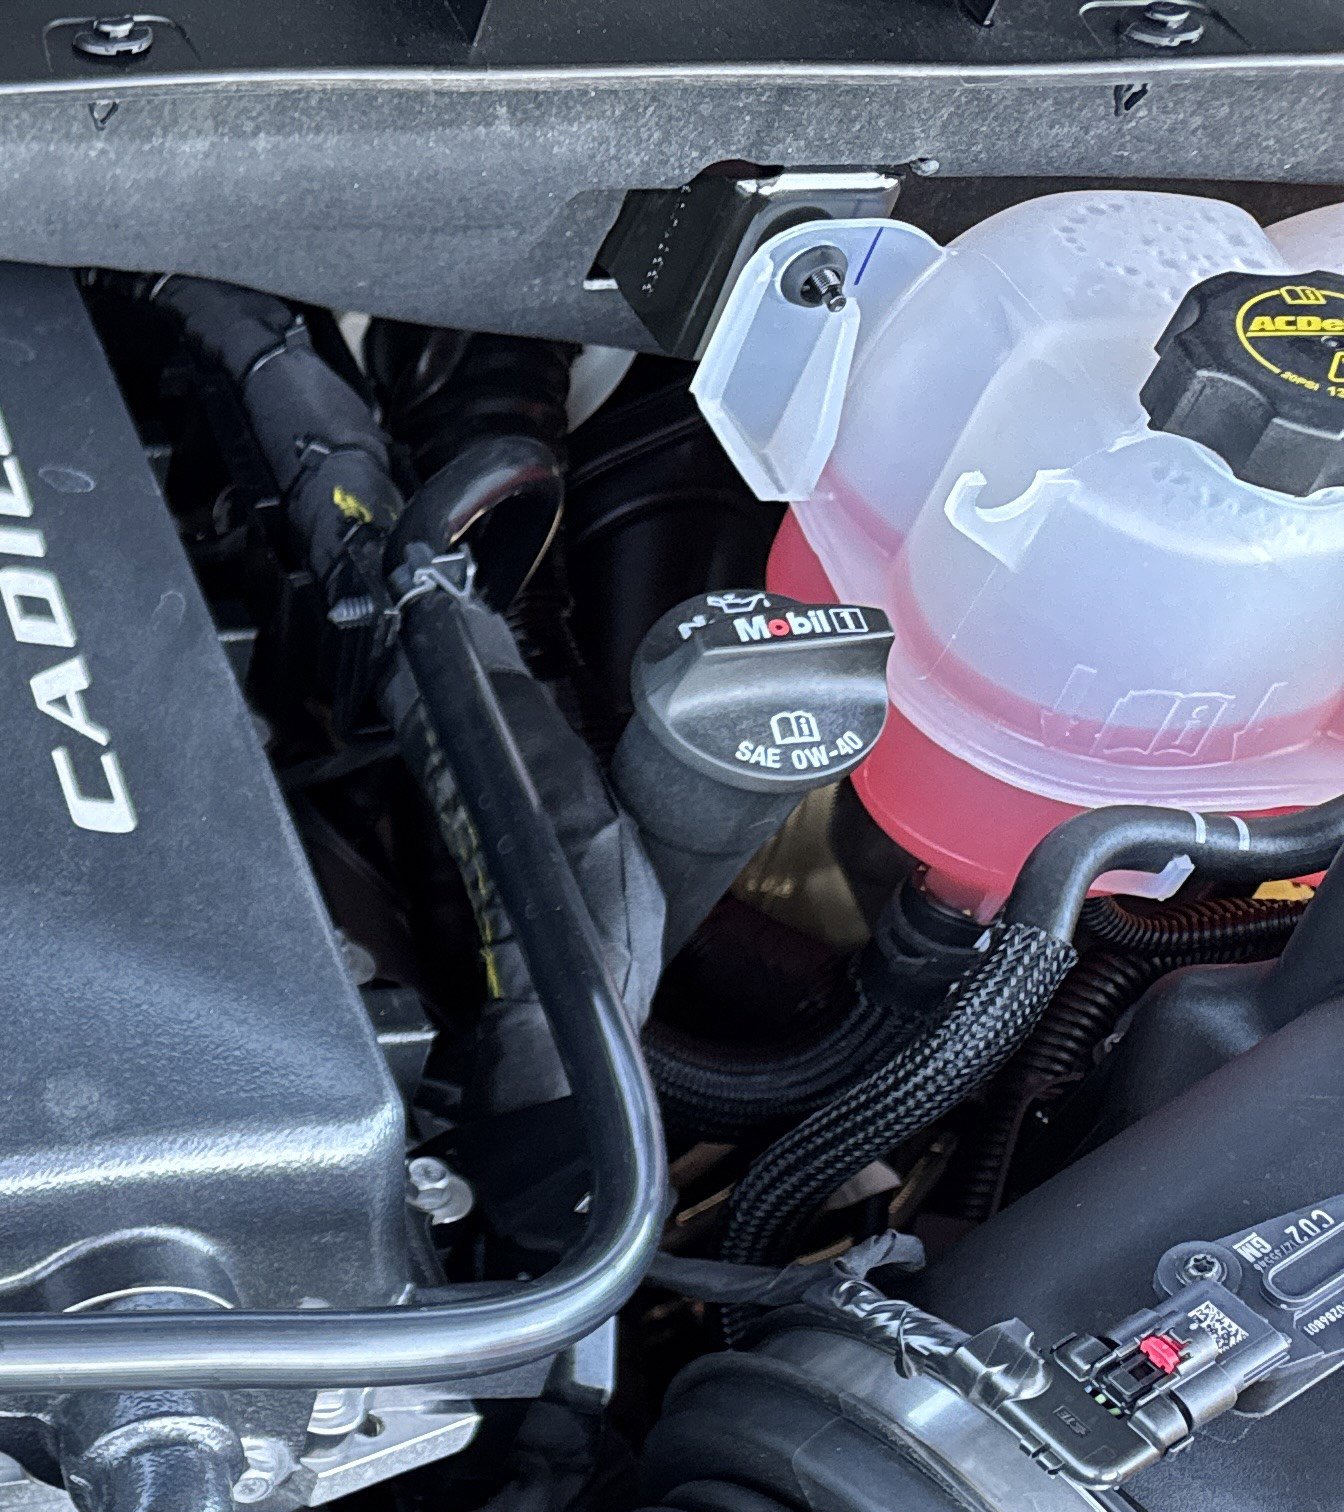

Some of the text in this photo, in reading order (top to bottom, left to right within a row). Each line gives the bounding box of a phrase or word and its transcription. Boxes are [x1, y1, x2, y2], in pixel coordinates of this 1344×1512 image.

[733, 608, 832, 642] Mobil
[735, 731, 864, 769] SAE 0W-40
[1233, 1234, 1272, 1263] GM
